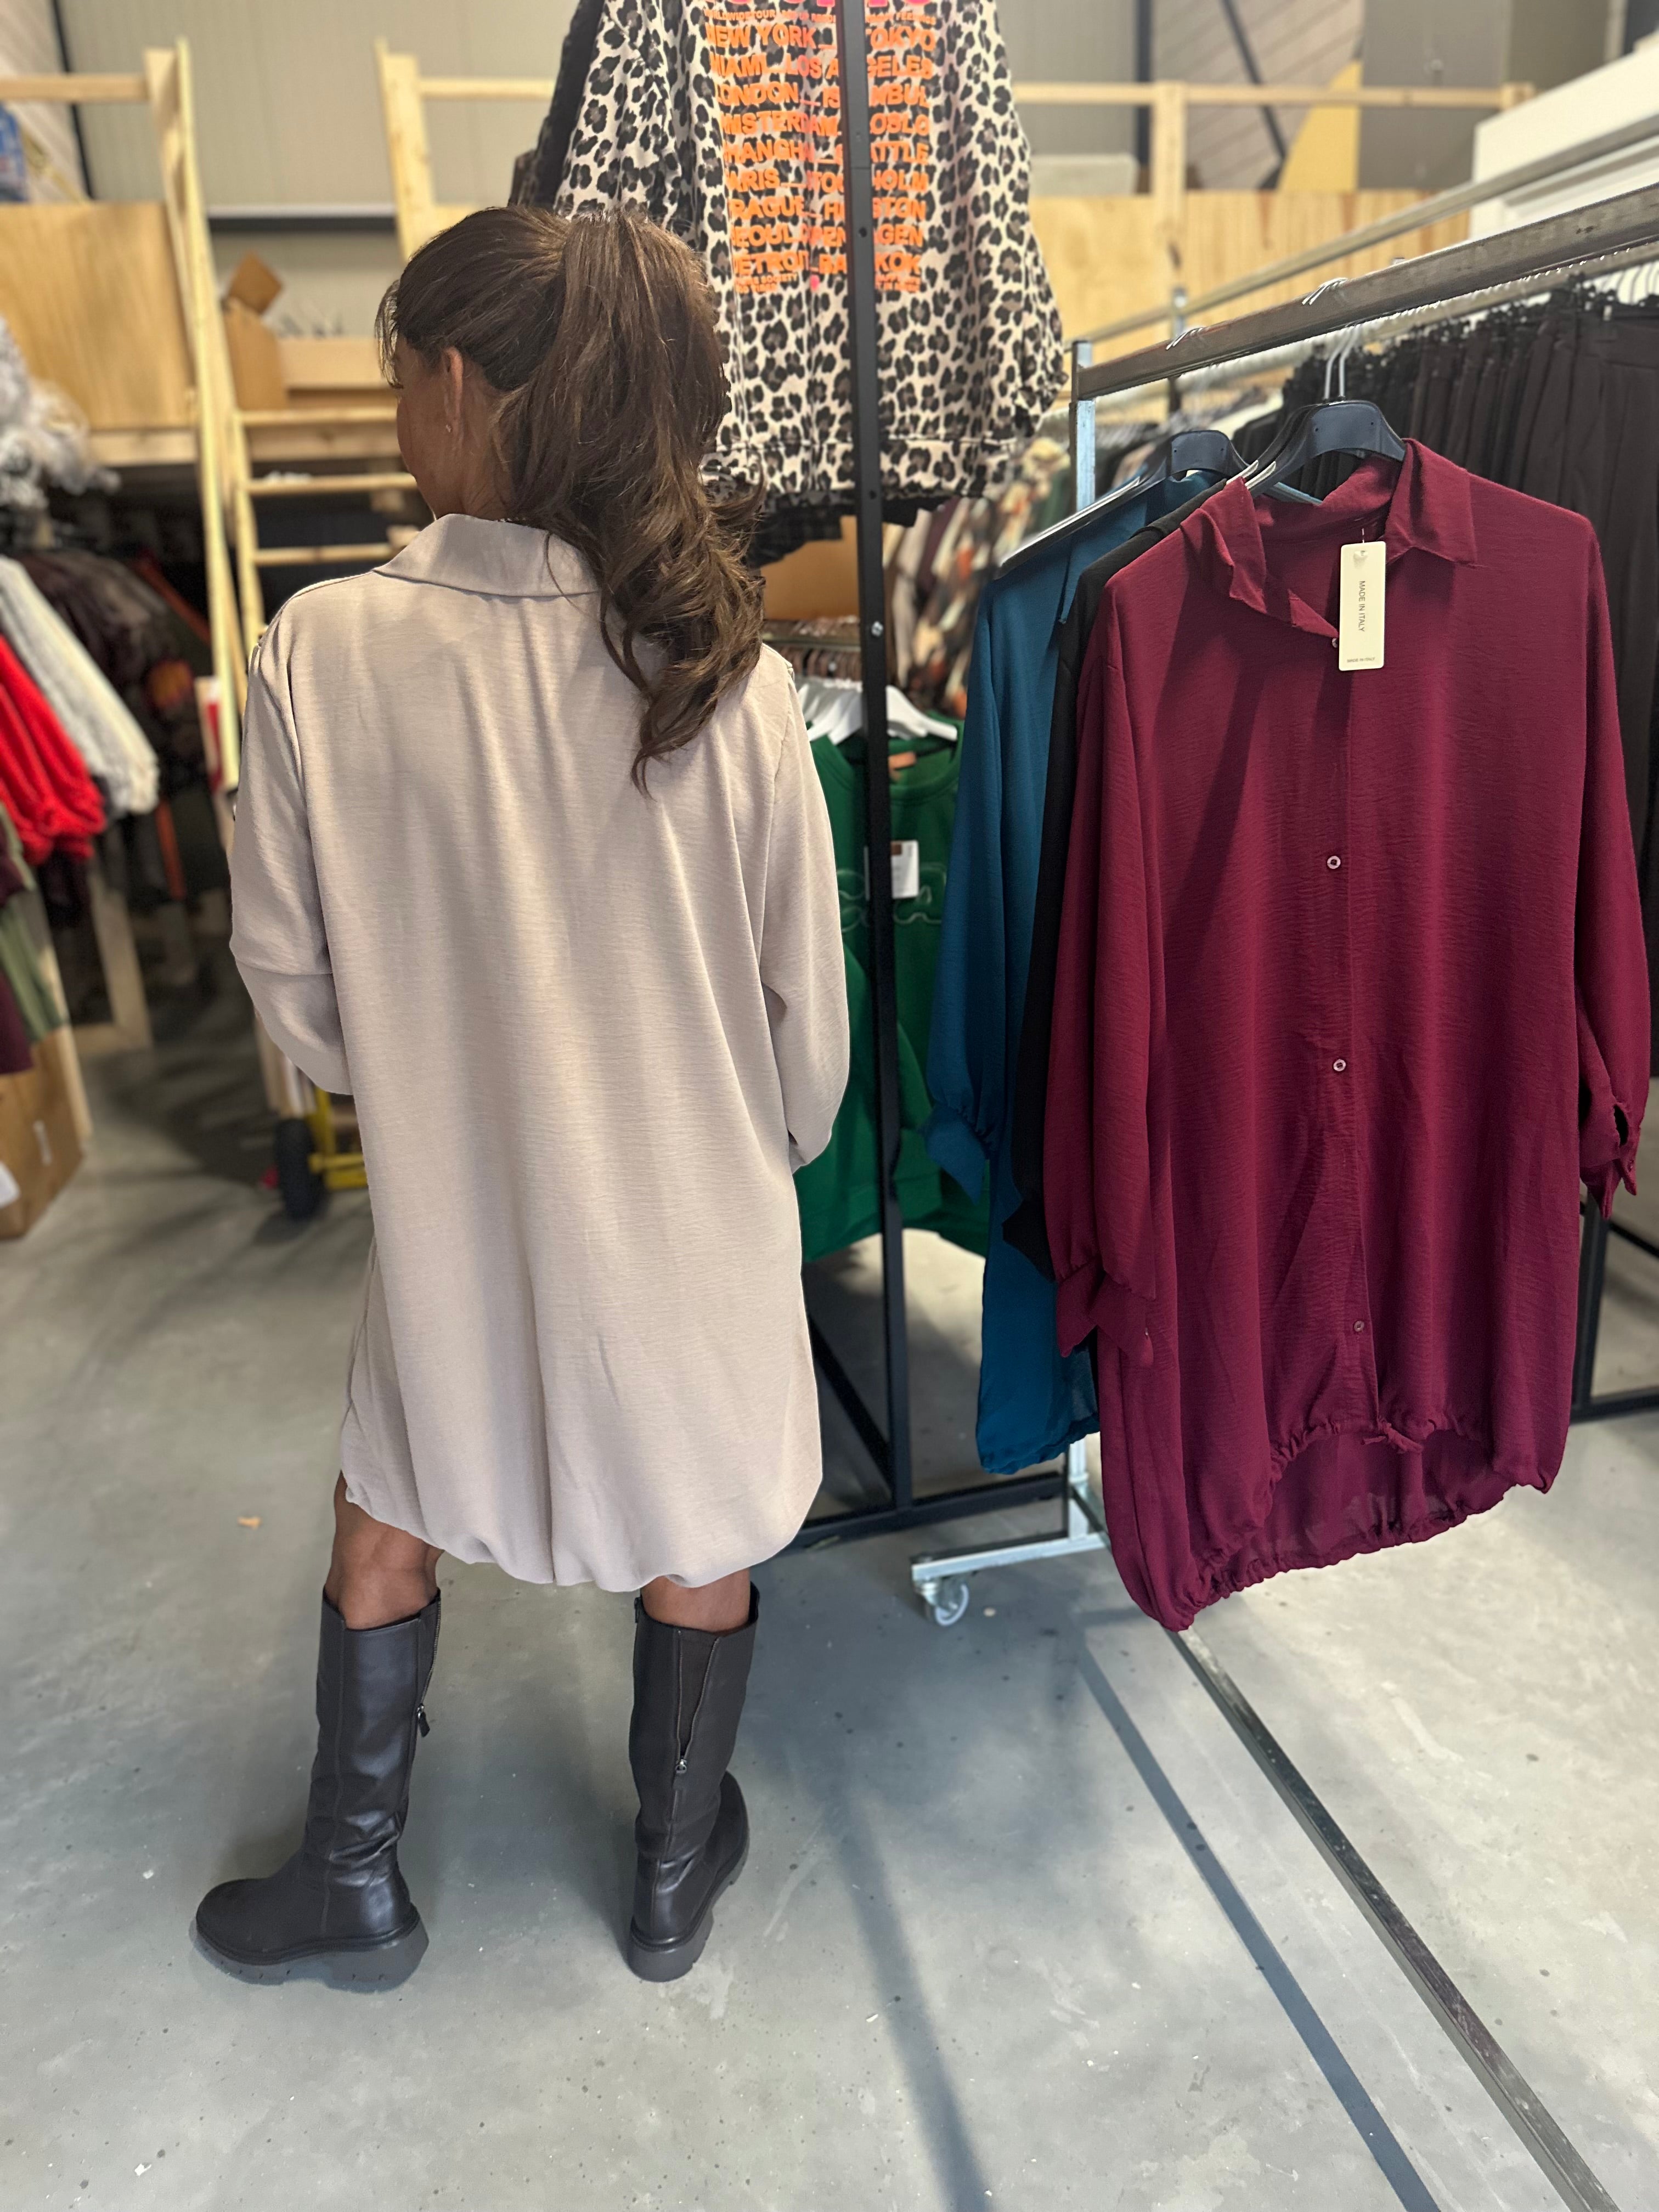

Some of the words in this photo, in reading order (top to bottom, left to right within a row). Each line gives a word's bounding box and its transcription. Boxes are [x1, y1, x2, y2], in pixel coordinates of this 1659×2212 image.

[705, 22, 751, 48] NEW
[755, 23, 816, 49] YORK
[865, 26, 936, 52] OKYO
[710, 51, 768, 78] MIAMI
[785, 53, 822, 79] LOS
[716, 81, 799, 106] LONDON
[870, 112, 930, 137] OSLO
[725, 168, 780, 192] ARIS
[729, 195, 804, 220] RAGUE
